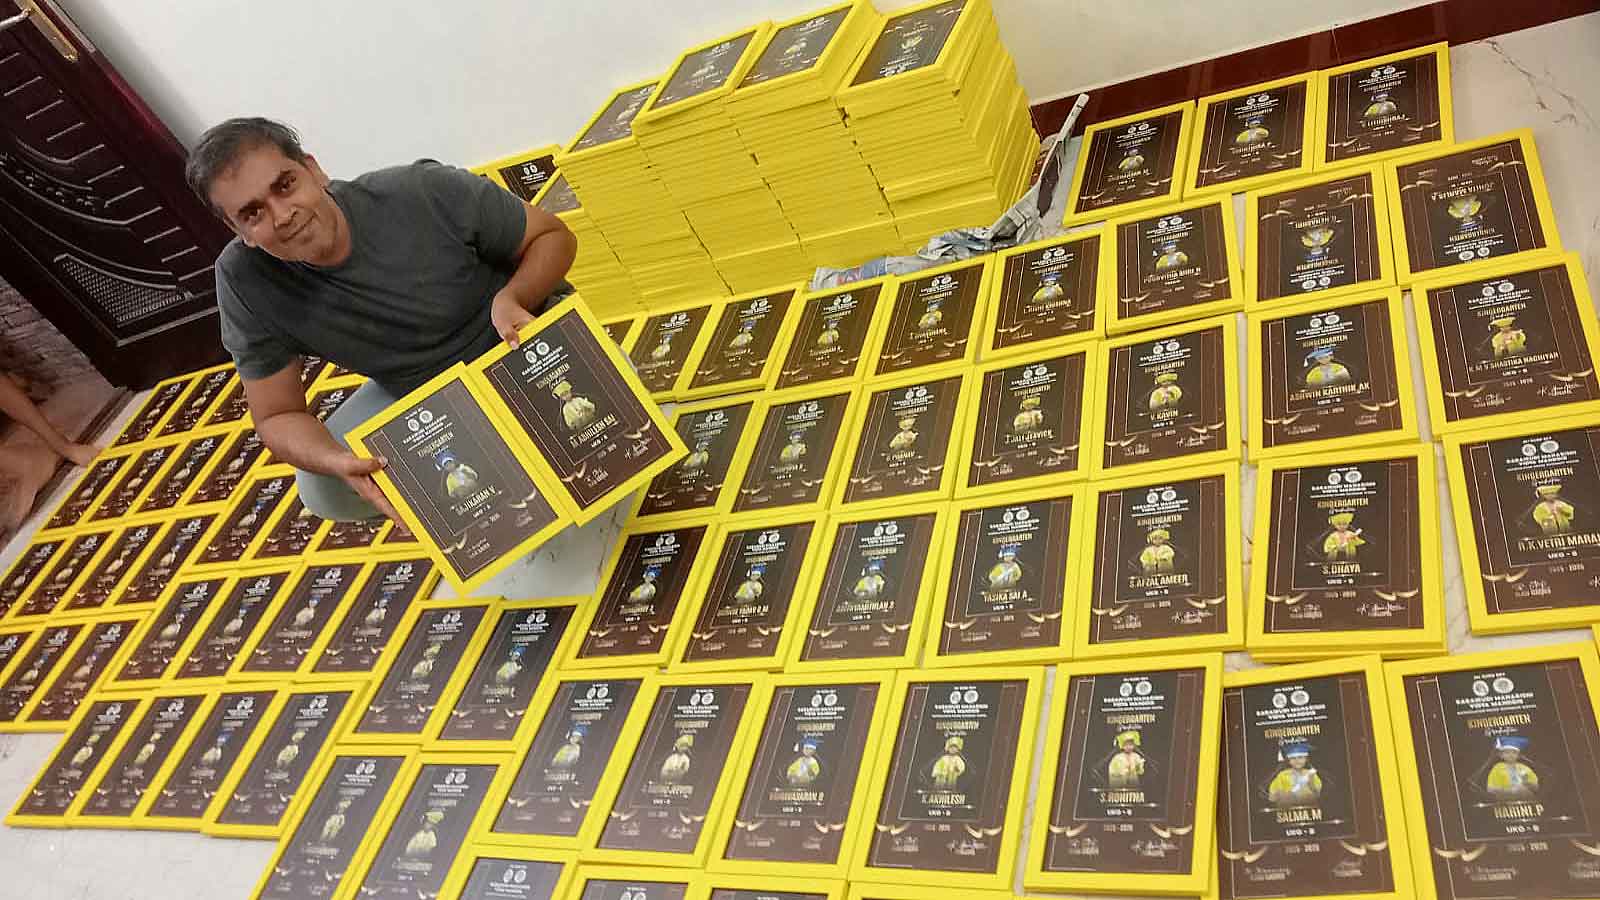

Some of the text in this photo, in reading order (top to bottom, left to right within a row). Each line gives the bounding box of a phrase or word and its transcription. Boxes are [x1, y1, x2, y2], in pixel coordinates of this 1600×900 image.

[1517, 467, 1574, 481] KINDERGARTEN
[1467, 714, 1531, 729] KINDERGARTEN
[1264, 724, 1321, 739] KINDERGARTEN
